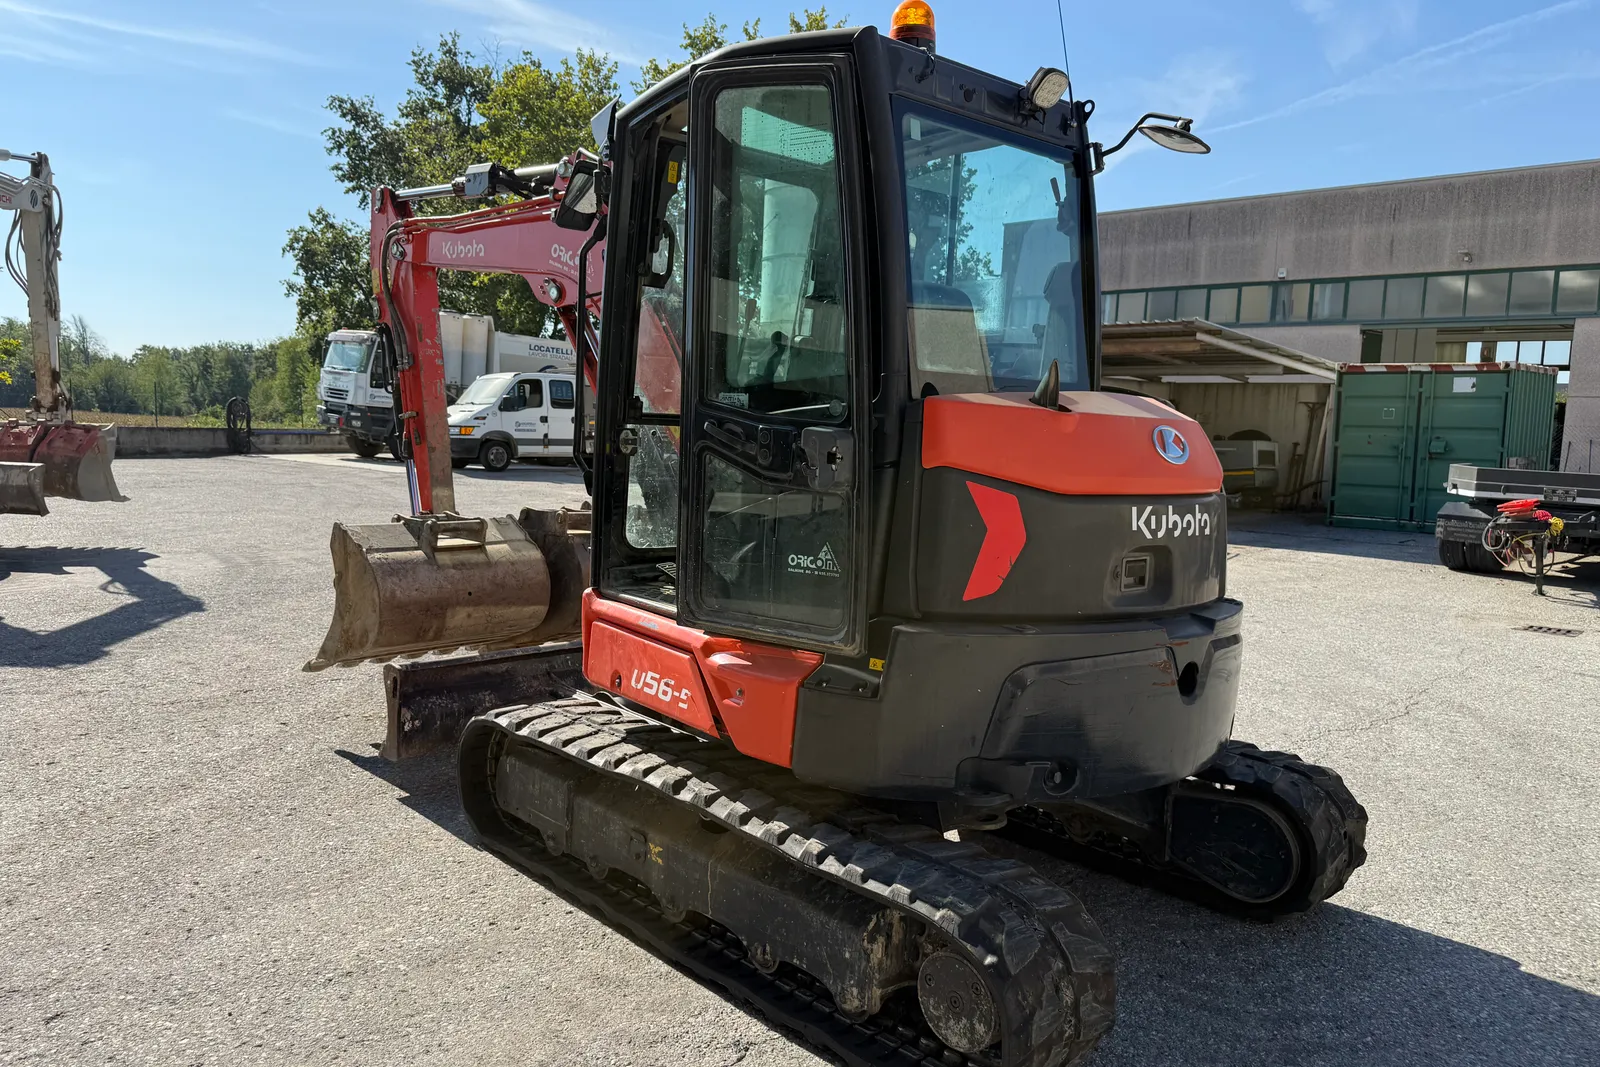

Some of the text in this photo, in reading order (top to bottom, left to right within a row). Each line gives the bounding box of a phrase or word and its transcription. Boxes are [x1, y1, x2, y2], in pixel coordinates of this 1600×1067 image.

[442, 239, 485, 259] Kubota
[529, 344, 573, 356] LOCATELLI
[1131, 504, 1210, 539] Kubota
